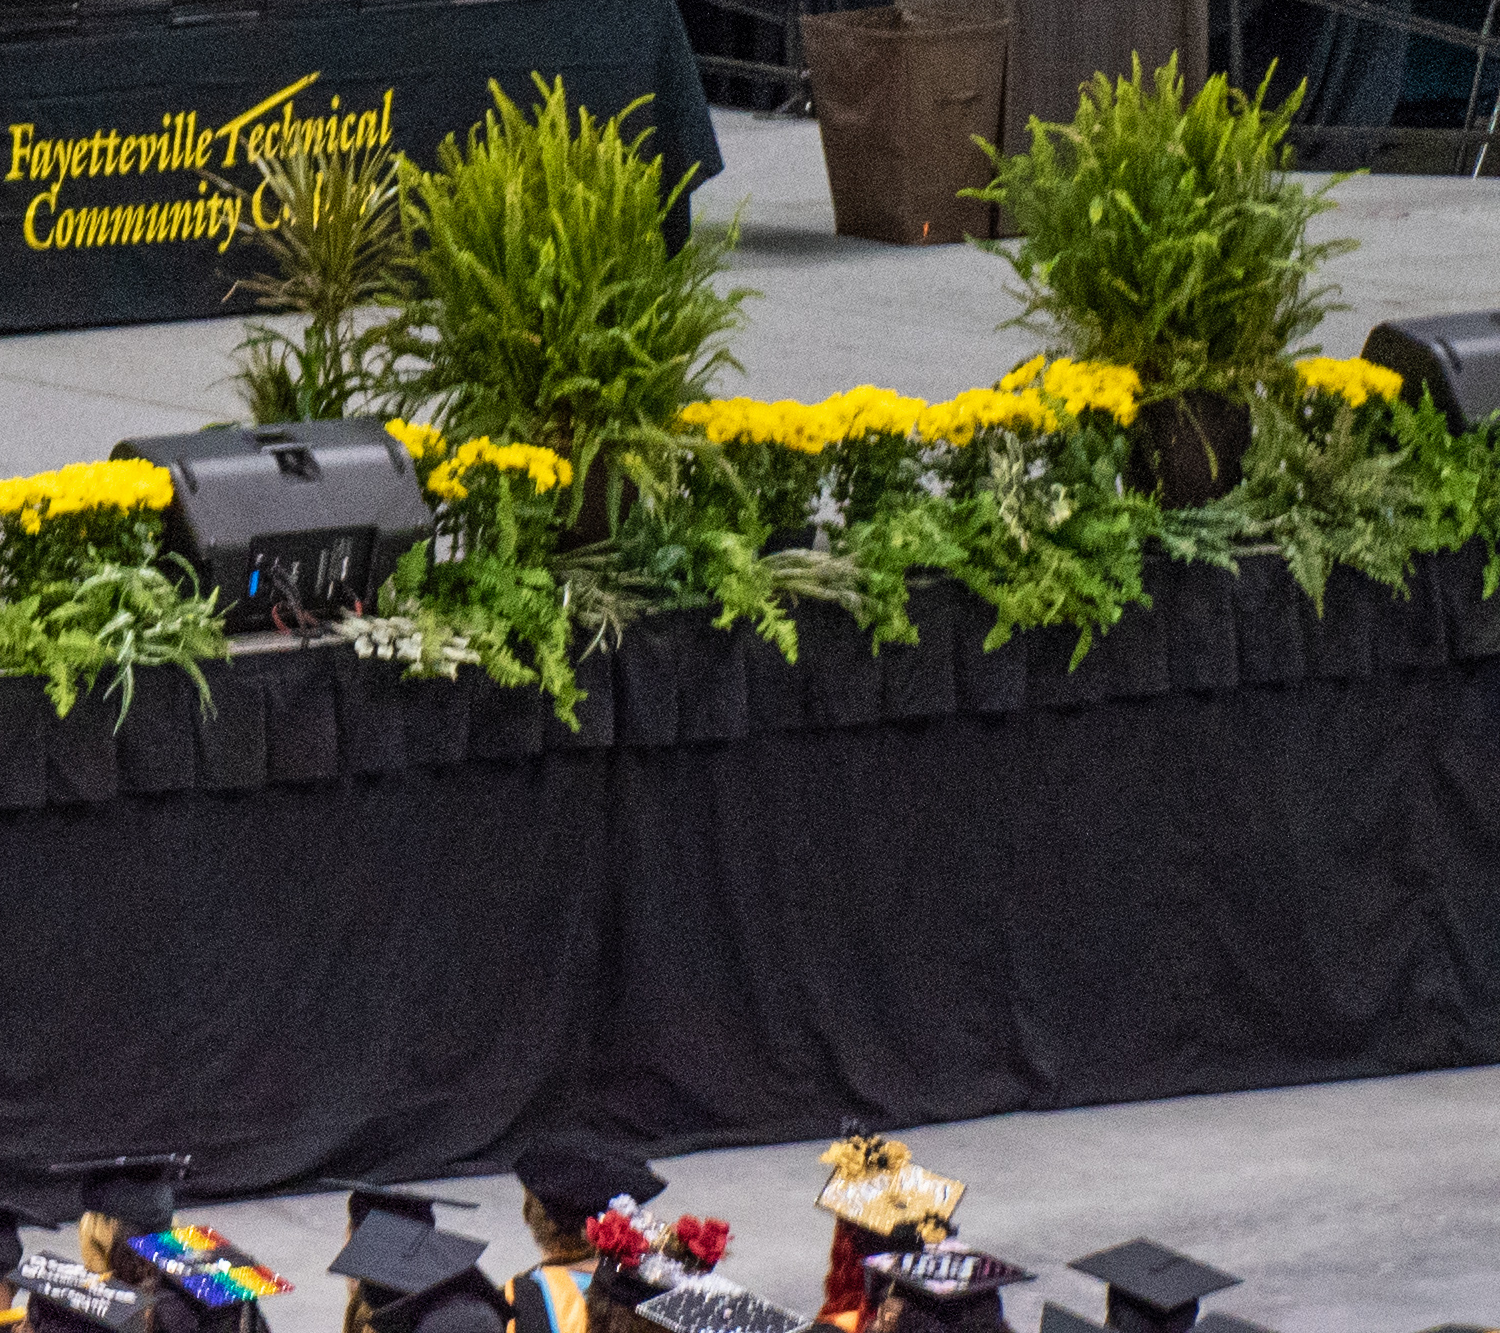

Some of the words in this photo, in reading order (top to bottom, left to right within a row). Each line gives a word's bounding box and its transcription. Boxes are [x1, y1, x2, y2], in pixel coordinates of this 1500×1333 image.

[5, 111, 213, 192] Fayetteville
[215, 71, 394, 168] Technical
[23, 181, 243, 254] Community
